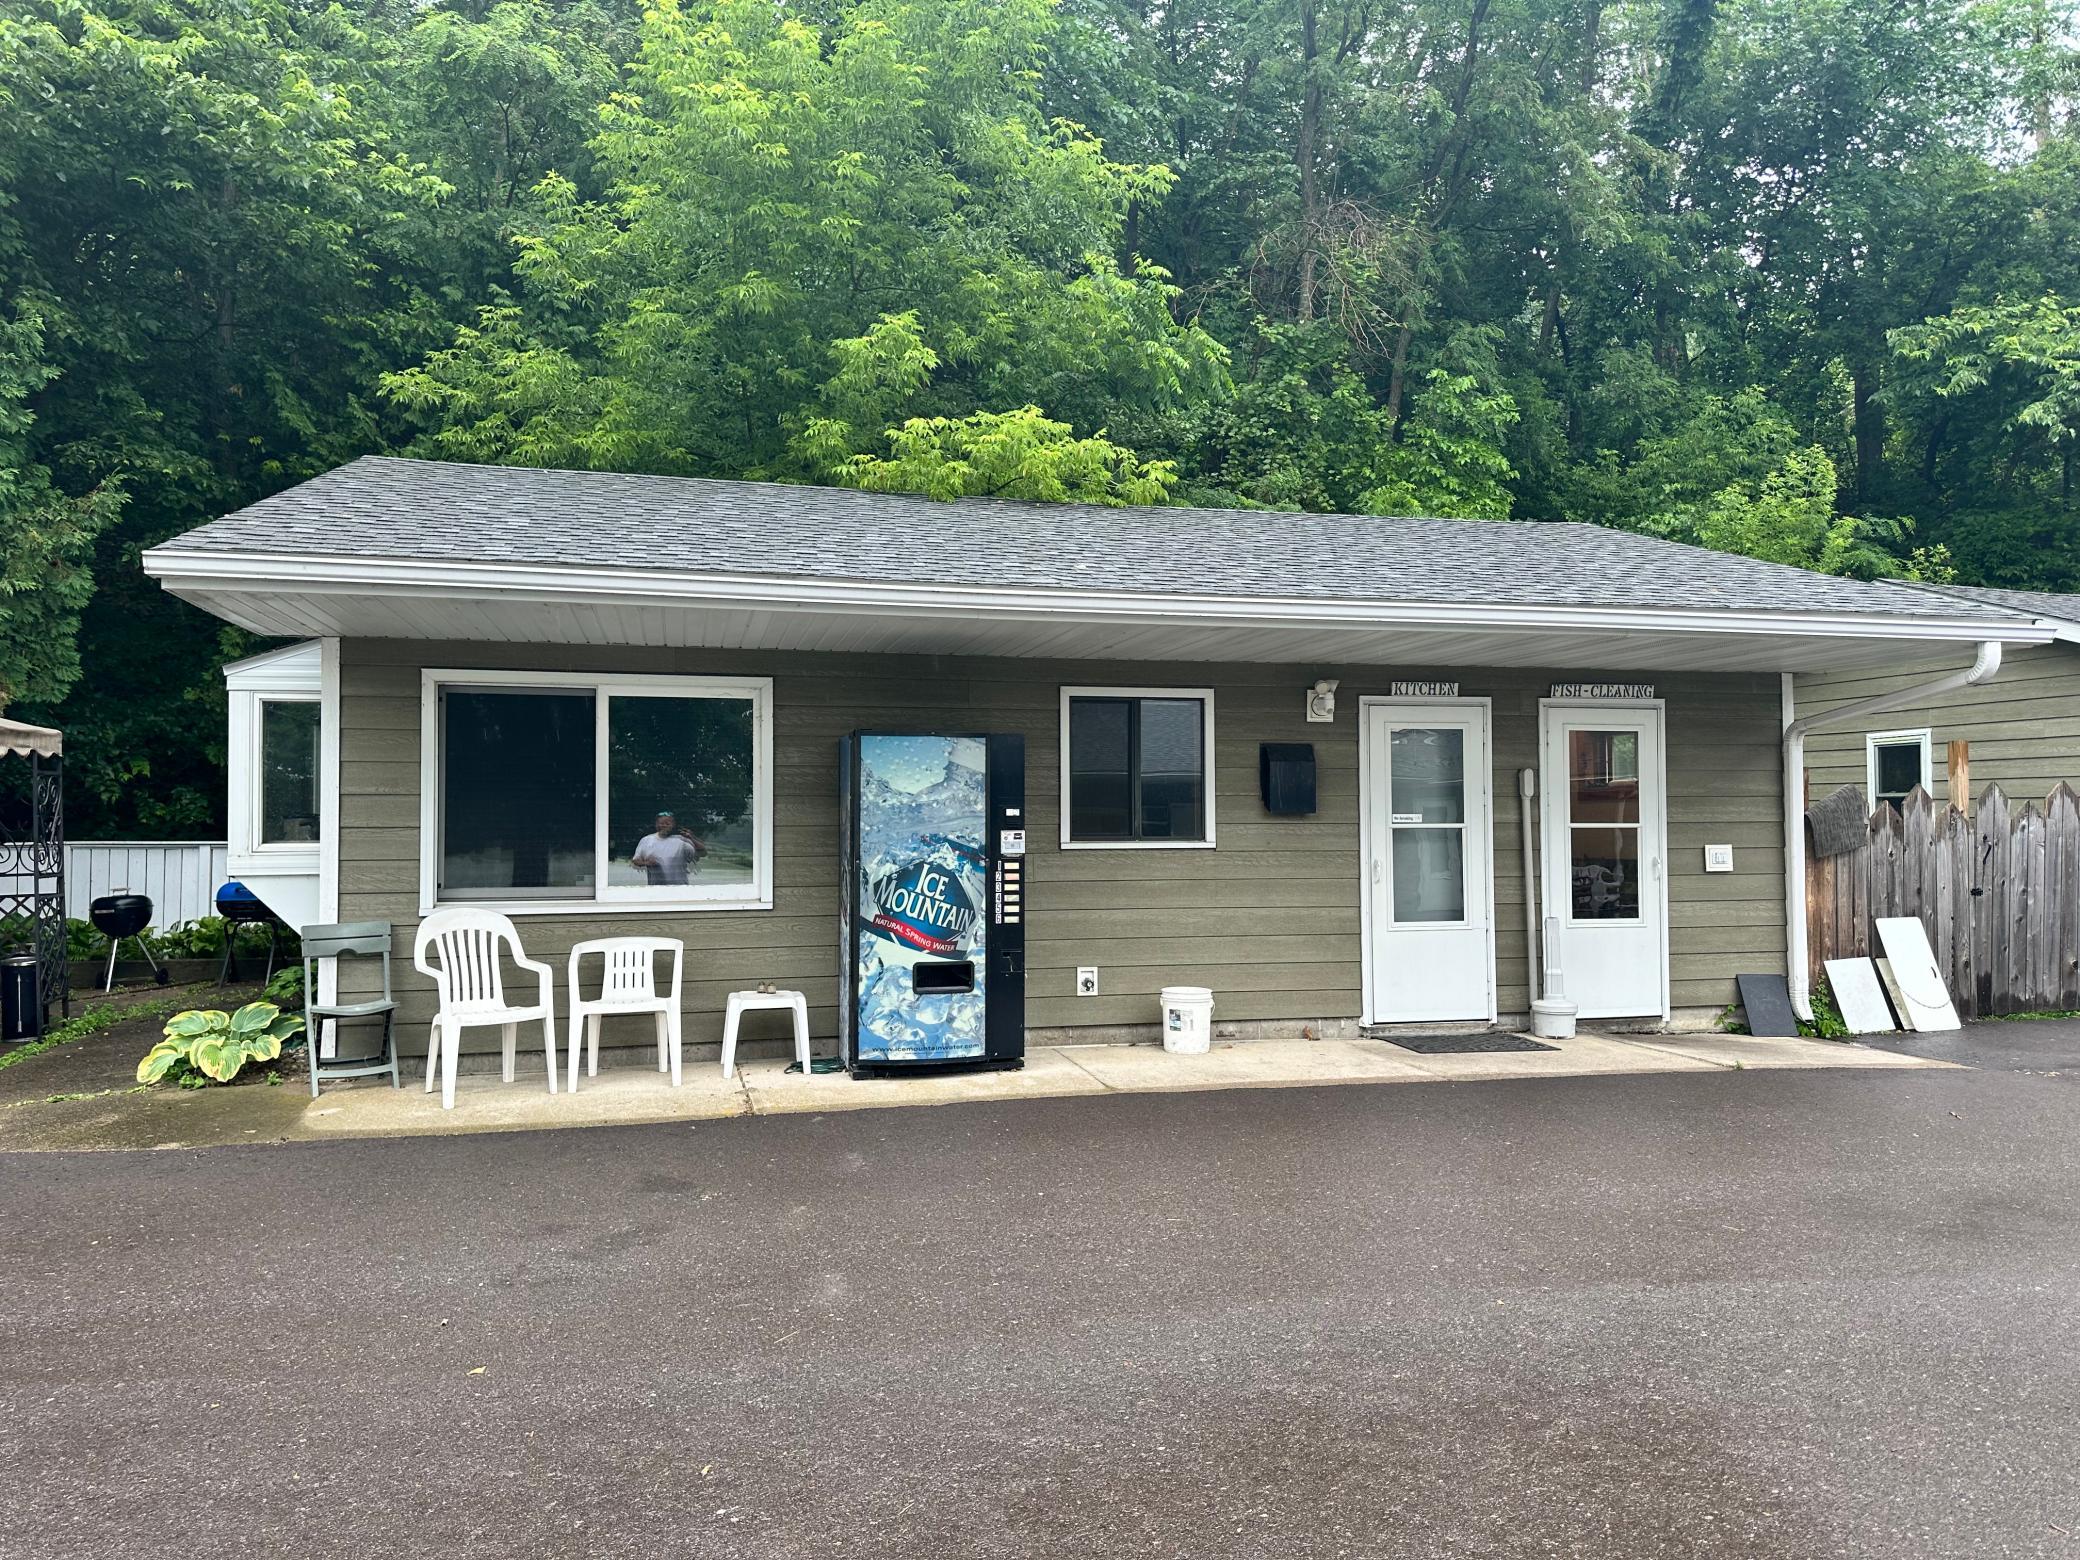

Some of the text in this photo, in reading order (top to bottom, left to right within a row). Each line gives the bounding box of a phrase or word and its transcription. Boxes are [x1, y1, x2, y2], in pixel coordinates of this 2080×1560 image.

[1394, 682, 1457, 696] KITCHEN
[1551, 684, 1654, 698] FISH-CLEANING
[914, 863, 949, 900] ICE
[873, 876, 973, 933] MOUNTAIN
[874, 917, 955, 951] NATURAL SPRING WATER
[872, 1044, 979, 1053] www.icemountainwater.com
